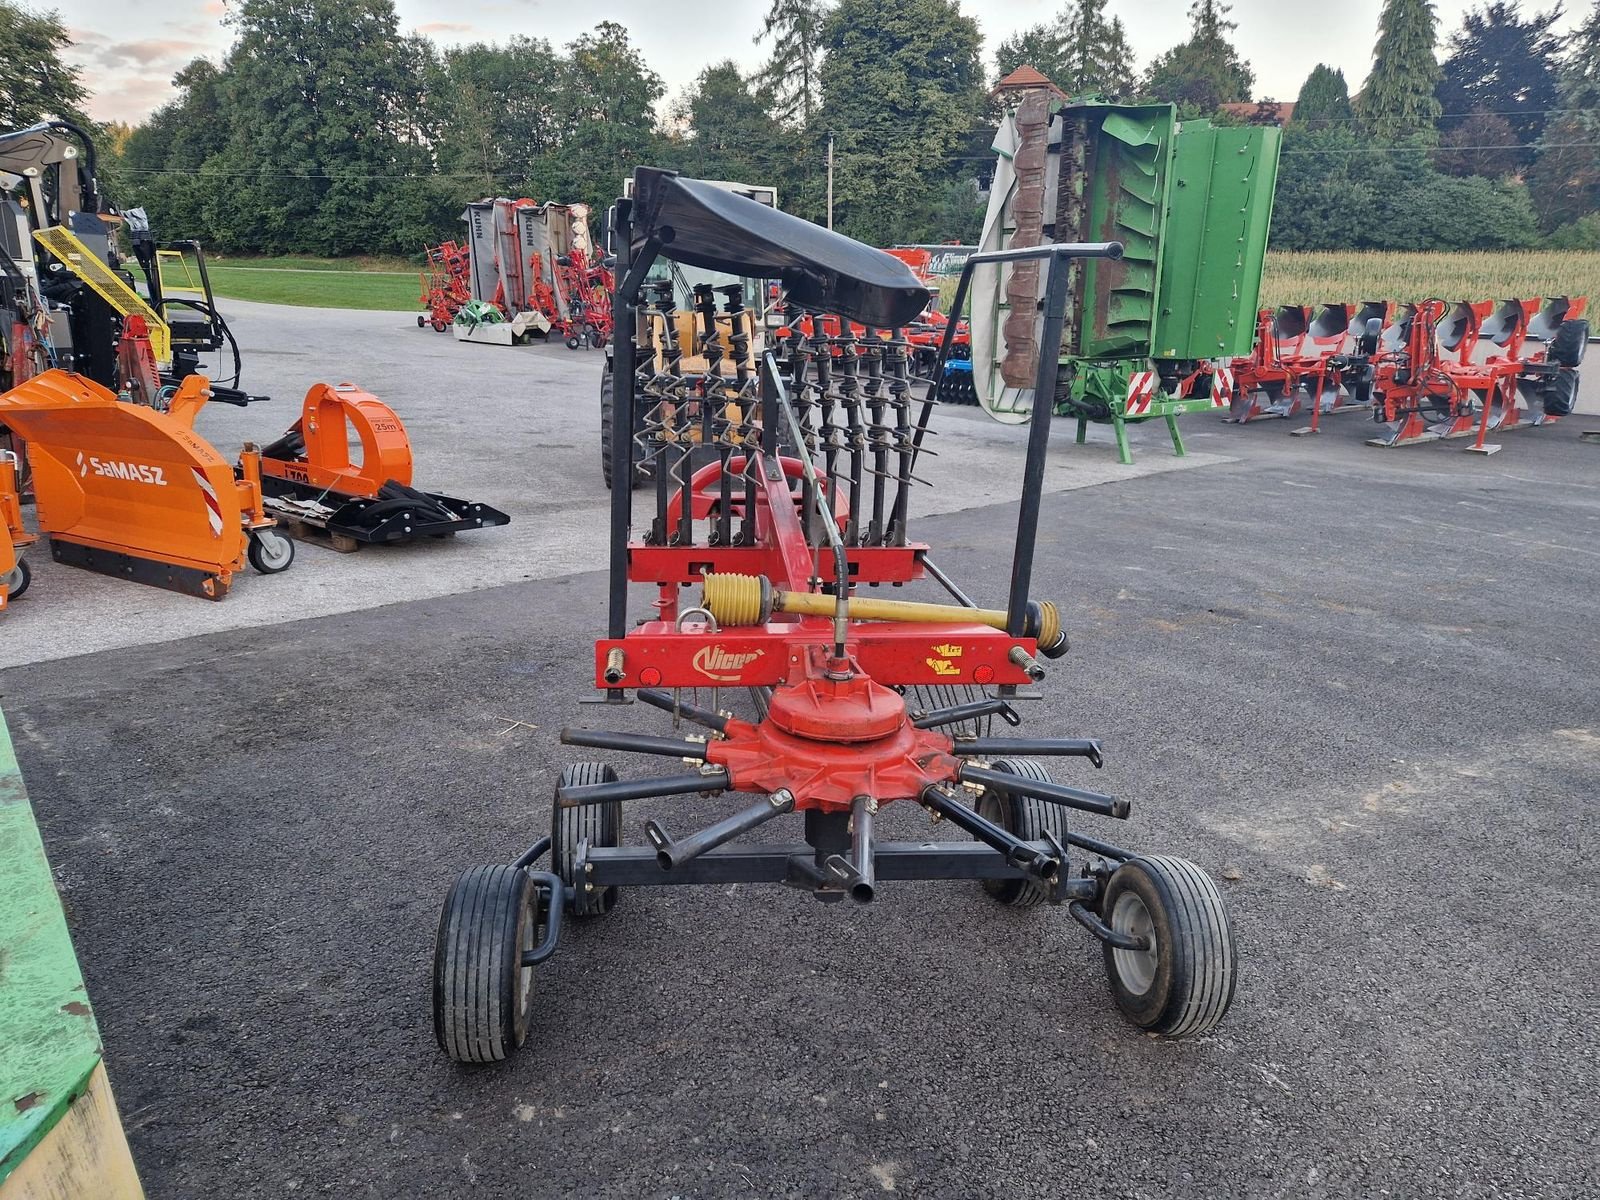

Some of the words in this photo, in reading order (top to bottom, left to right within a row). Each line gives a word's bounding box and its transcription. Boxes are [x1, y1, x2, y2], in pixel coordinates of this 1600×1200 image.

[474, 211, 483, 239] KUHN
[525, 216, 534, 246] KUHN
[375, 423, 396, 431] 25m
[89, 457, 168, 486] SaMASZ
